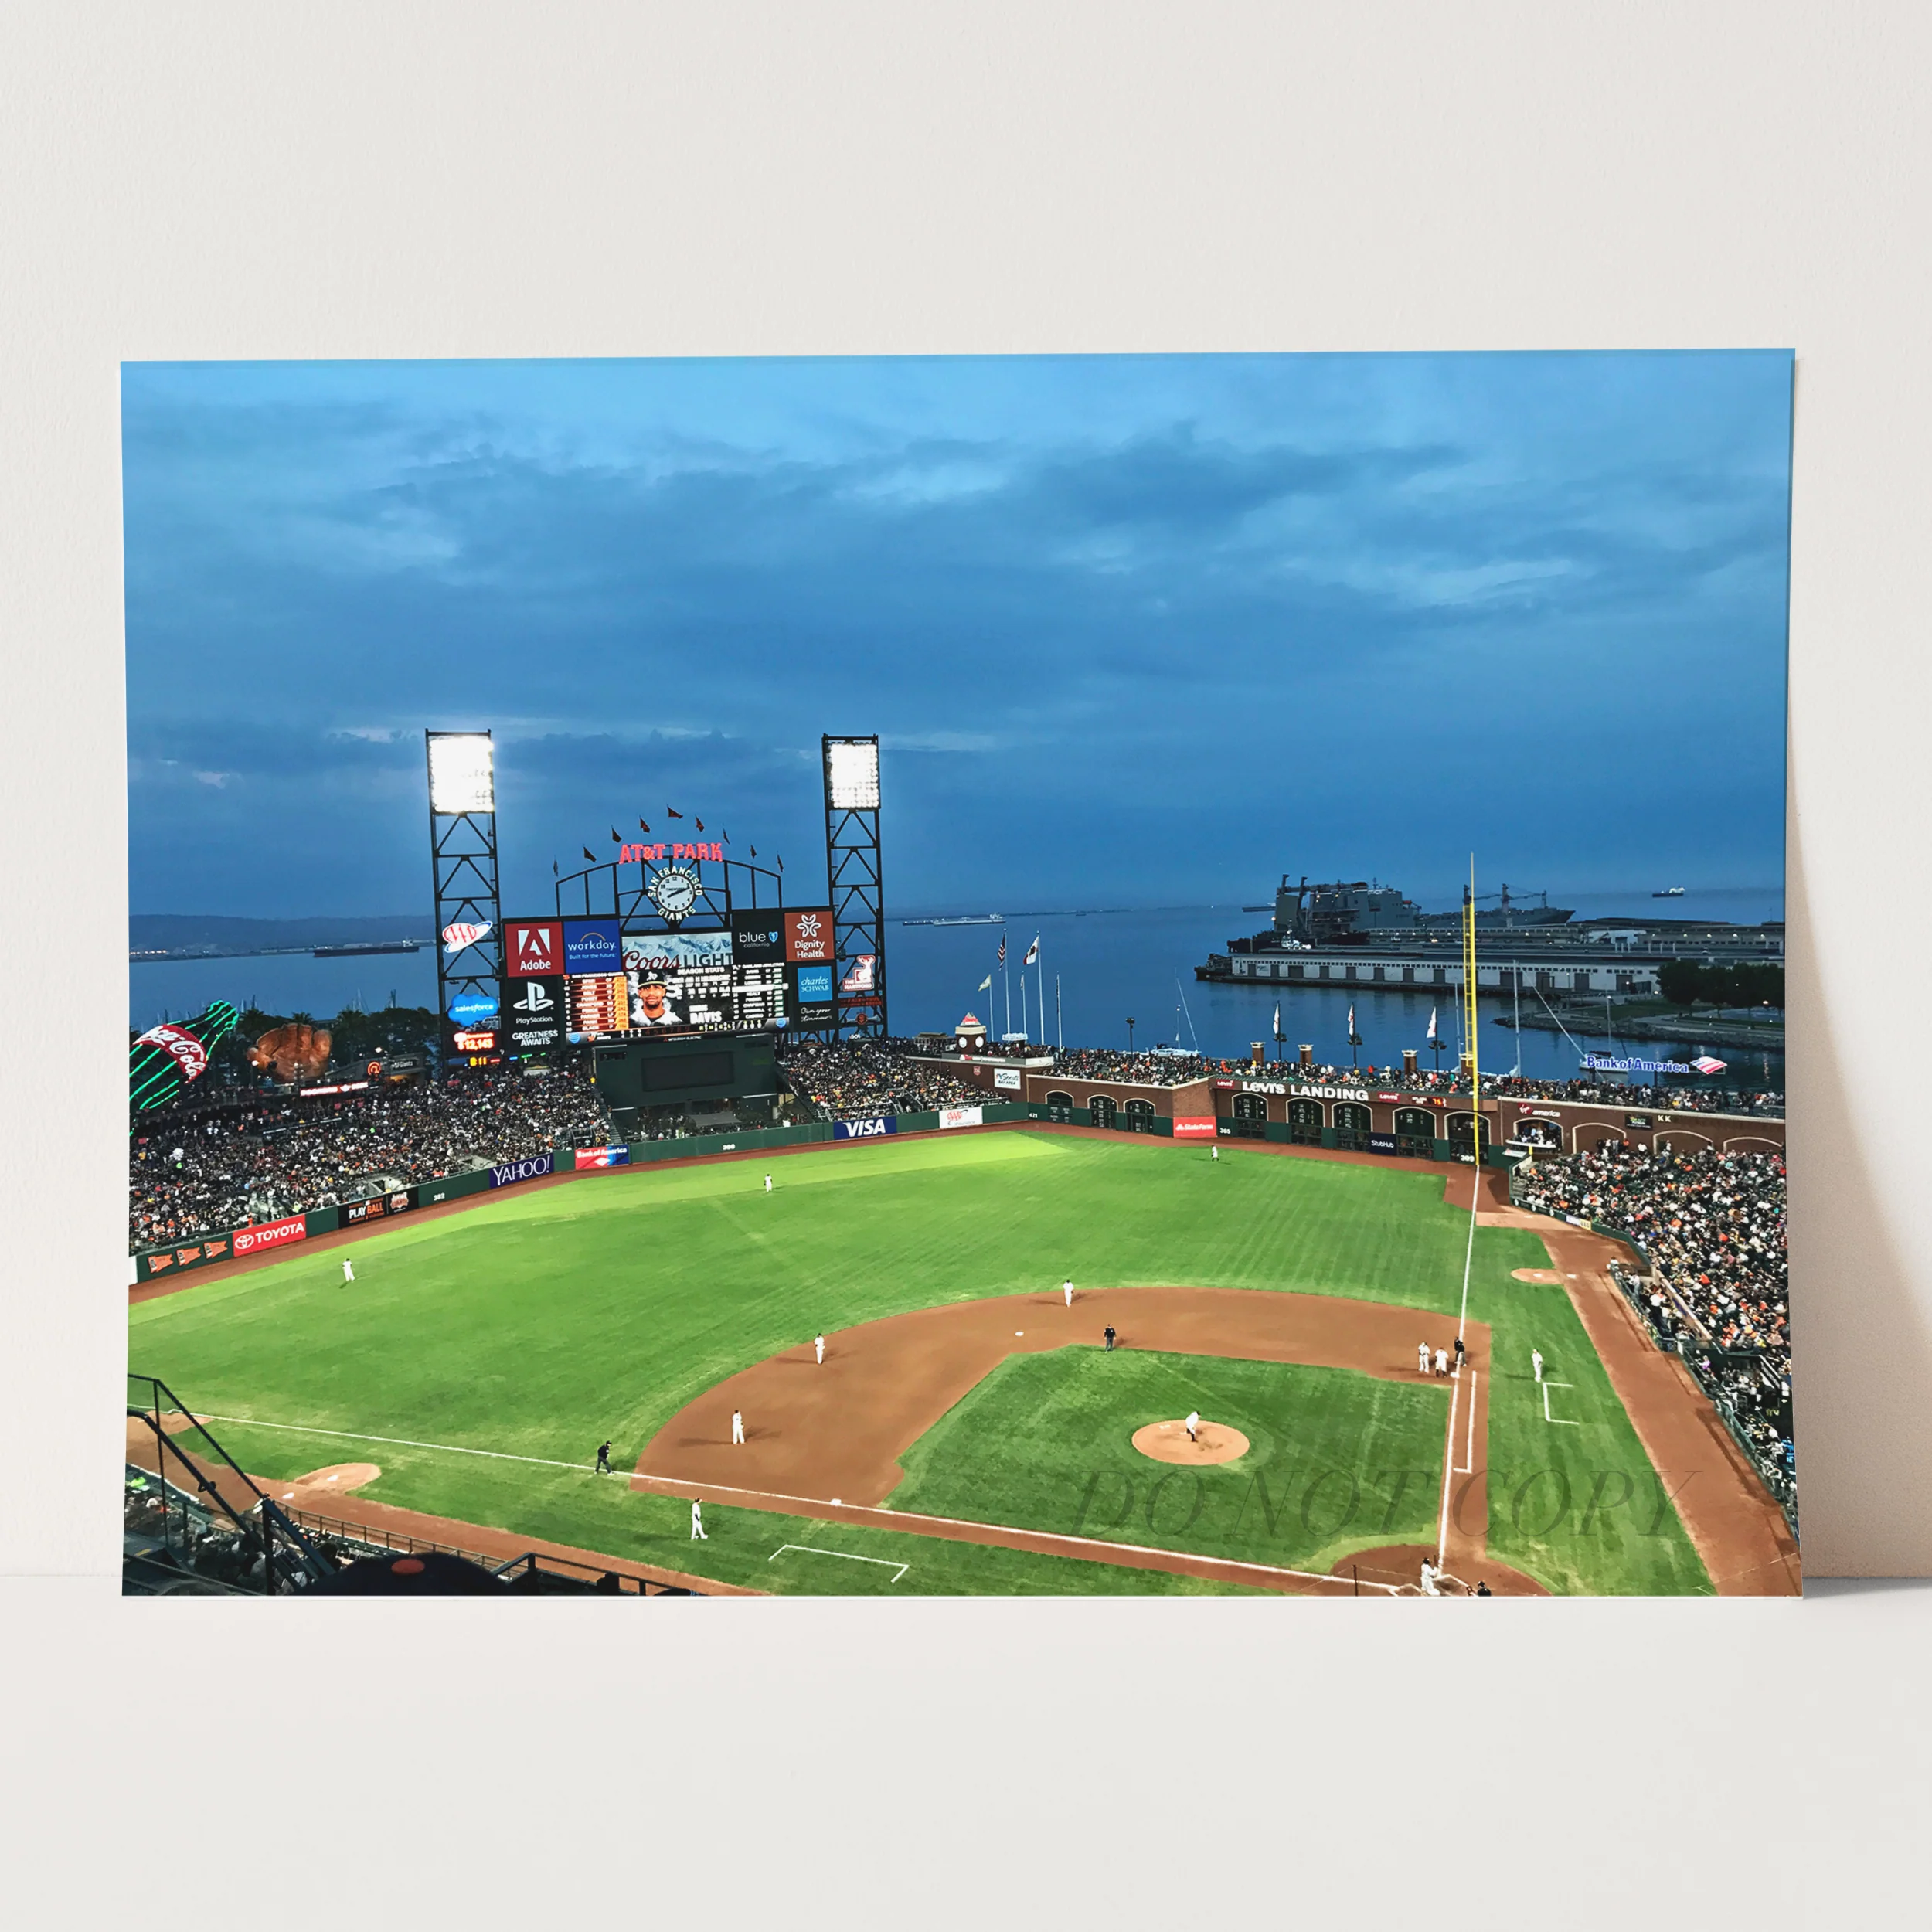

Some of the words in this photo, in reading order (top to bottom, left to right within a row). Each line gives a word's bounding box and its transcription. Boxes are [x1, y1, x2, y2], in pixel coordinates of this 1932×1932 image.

[619, 843, 666, 864] AT&T
[672, 842, 723, 862] PARK
[648, 876, 660, 898] SAN
[658, 866, 703, 896] FRANCISCO
[658, 906, 696, 920] GIANTS
[739, 931, 766, 943] blue
[794, 940, 825, 950] Dignity
[622, 950, 681, 970] Coors
[683, 953, 733, 967] LIGHT
[797, 950, 825, 958] Health
[520, 960, 551, 971] Adobe
[677, 967, 704, 975] SEASON
[801, 976, 829, 985] charles
[454, 1003, 494, 1014] salesforce
[516, 1016, 553, 1025] PlayStation
[689, 1011, 723, 1024] DAVIS
[512, 1030, 559, 1040] GREATNESS
[520, 1038, 551, 1047] AWAITS
[1587, 1056, 1616, 1069] Bank
[1616, 1057, 1633, 1070] of
[1634, 1058, 1689, 1073] America
[1290, 1084, 1369, 1101] LANDING
[842, 1118, 886, 1137] VISA
[1371, 1139, 1394, 1148] StubHub
[600, 1147, 628, 1156] America
[493, 1155, 551, 1186] YAHOO!
[349, 1206, 366, 1219] PLAY
[367, 1202, 384, 1214] BALL
[255, 1222, 305, 1243] TOYOTA
